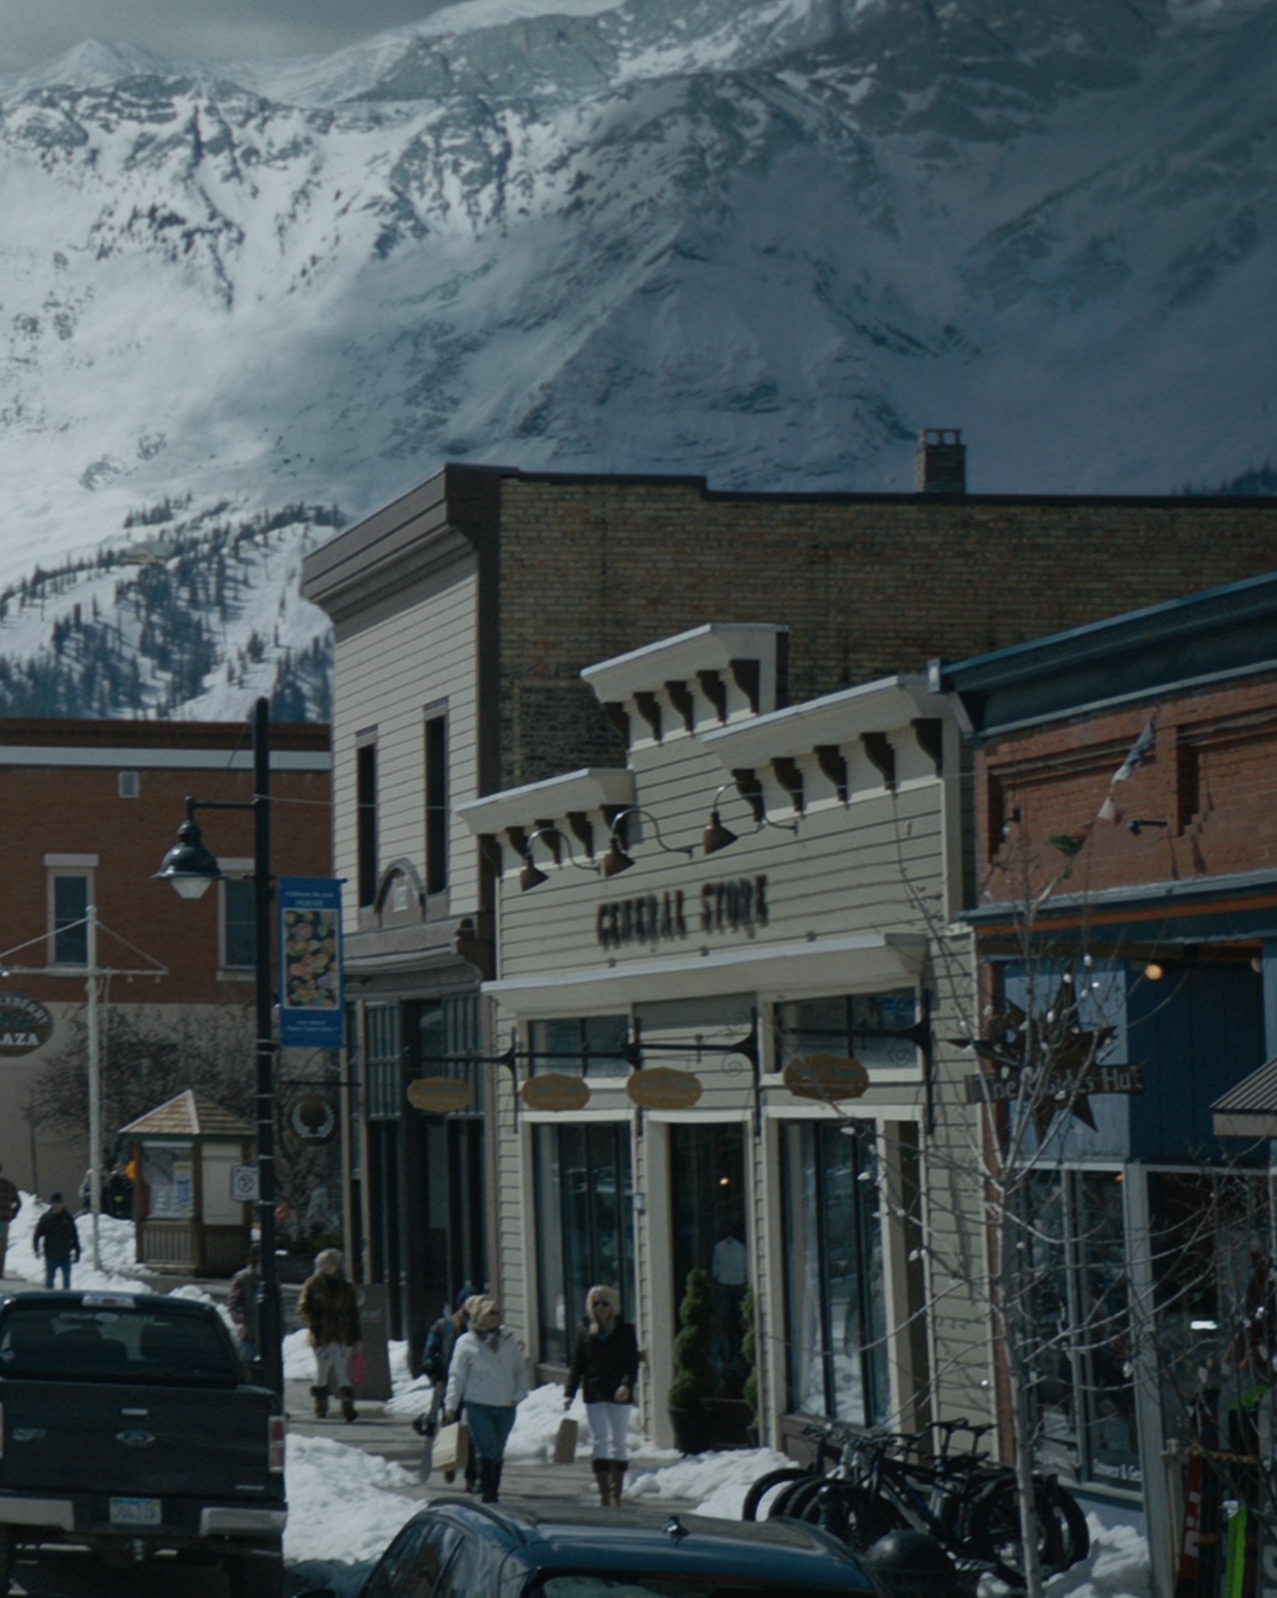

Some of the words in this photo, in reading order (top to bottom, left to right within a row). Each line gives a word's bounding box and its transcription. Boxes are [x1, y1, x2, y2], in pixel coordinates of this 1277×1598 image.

[597, 890, 686, 946] GENERAL
[701, 875, 768, 933] STORE
[1101, 1066, 1144, 1092] Hut
